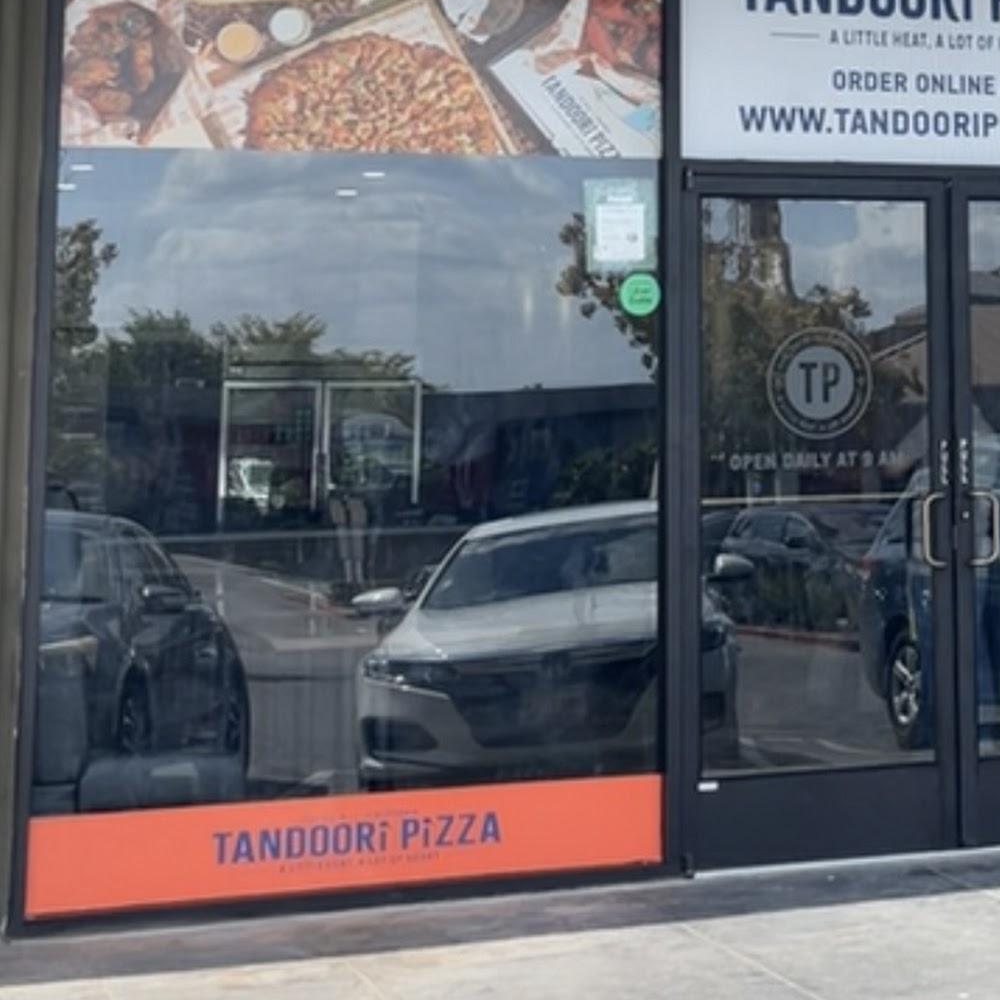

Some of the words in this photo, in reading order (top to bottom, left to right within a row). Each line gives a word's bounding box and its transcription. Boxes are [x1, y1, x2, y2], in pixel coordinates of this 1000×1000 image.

[829, 28, 840, 46] A
[843, 30, 889, 48] LITTLE
[935, 33, 945, 49] A
[949, 33, 974, 51] LOT
[976, 35, 994, 51] OF
[832, 69, 909, 93] ORDER
[915, 73, 996, 96] ONLINE
[799, 362, 841, 404] TP
[729, 451, 777, 471] OPEN
[836, 449, 858, 468] AT
